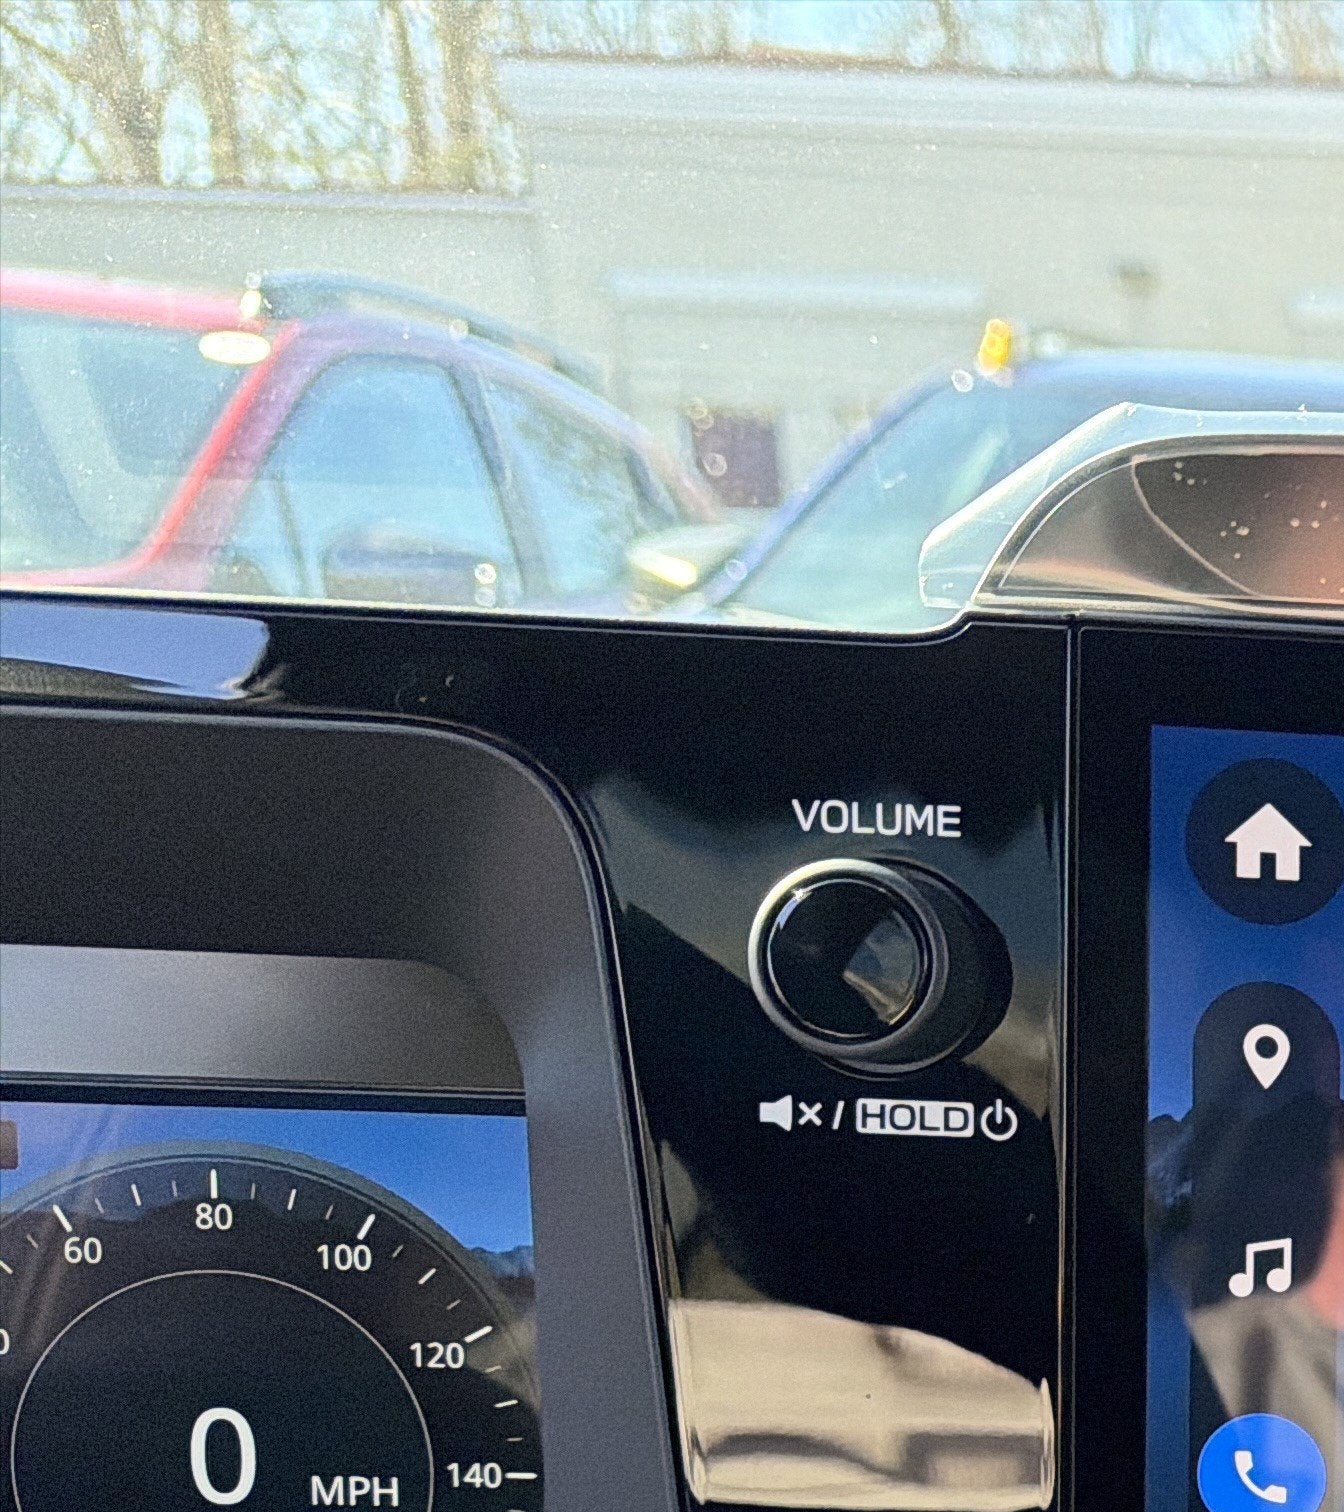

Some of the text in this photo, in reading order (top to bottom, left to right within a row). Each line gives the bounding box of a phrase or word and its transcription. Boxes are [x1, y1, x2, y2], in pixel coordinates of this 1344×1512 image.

[791, 798, 962, 838] VOLUME
[860, 1101, 971, 1134] HOLD
[195, 1201, 234, 1231] 80
[64, 1235, 102, 1265] 60
[316, 1243, 372, 1273] 100
[410, 1341, 466, 1370] 120
[190, 1407, 400, 1508] 0 MPH
[447, 1461, 502, 1490] 140
